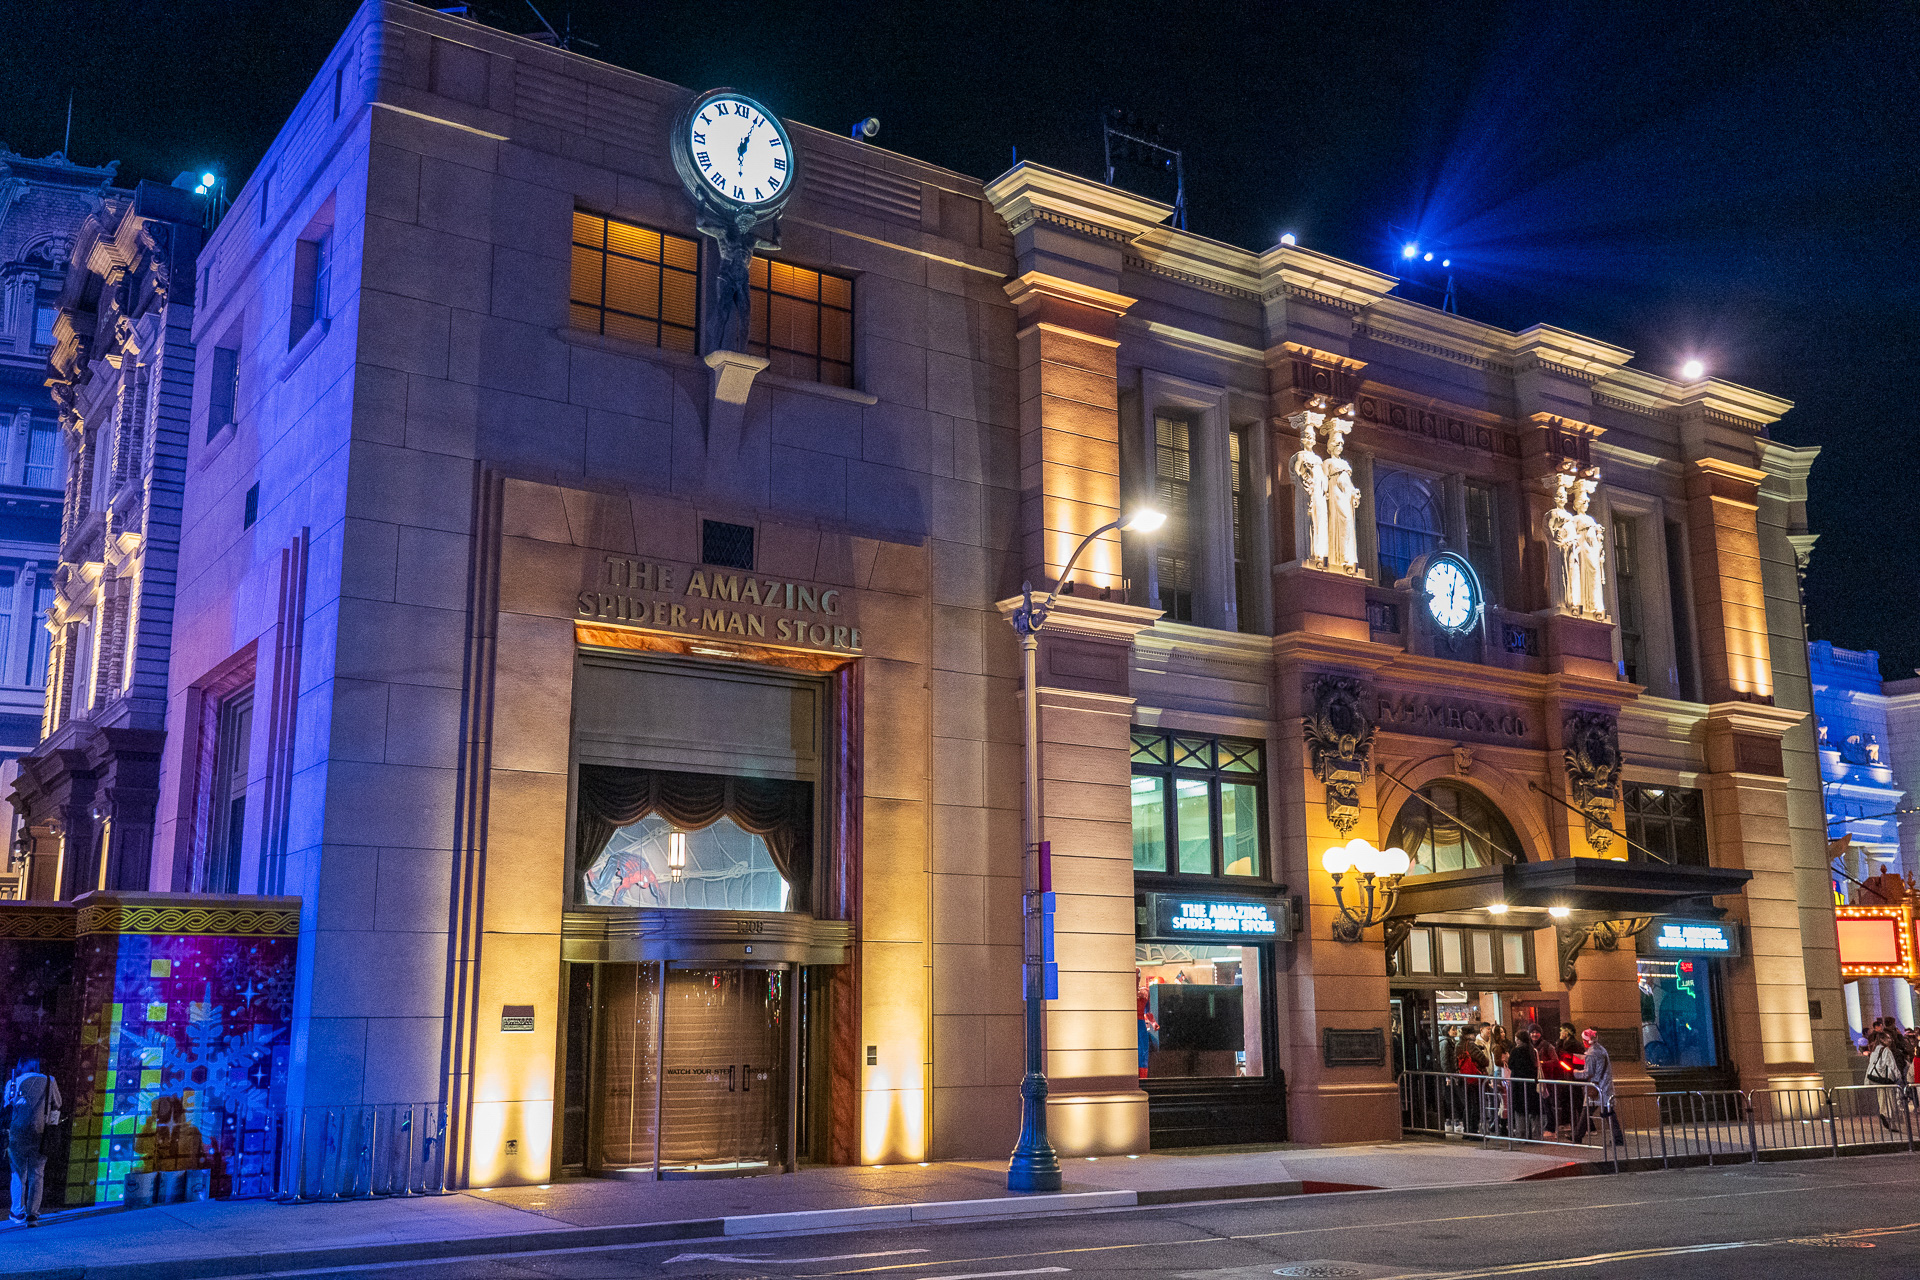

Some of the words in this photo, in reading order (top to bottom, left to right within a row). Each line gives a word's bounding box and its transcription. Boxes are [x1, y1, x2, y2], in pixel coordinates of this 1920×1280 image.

[714, 103, 729, 116] XI
[734, 103, 750, 119] XII
[699, 112, 713, 125] X
[694, 130, 706, 145] IX
[768, 137, 782, 147] II
[696, 151, 713, 172] VIII
[773, 157, 786, 171] III
[710, 171, 727, 190] VII
[733, 185, 745, 200] VI
[754, 187, 764, 200] V
[605, 555, 675, 594] THE
[685, 569, 840, 616] AMAZING
[577, 590, 766, 638] SPIDER-MAN
[775, 617, 863, 650] STORE
[1181, 903, 1207, 918] THE
[1209, 904, 1267, 920] AMAZING
[1241, 920, 1276, 932] STORE
